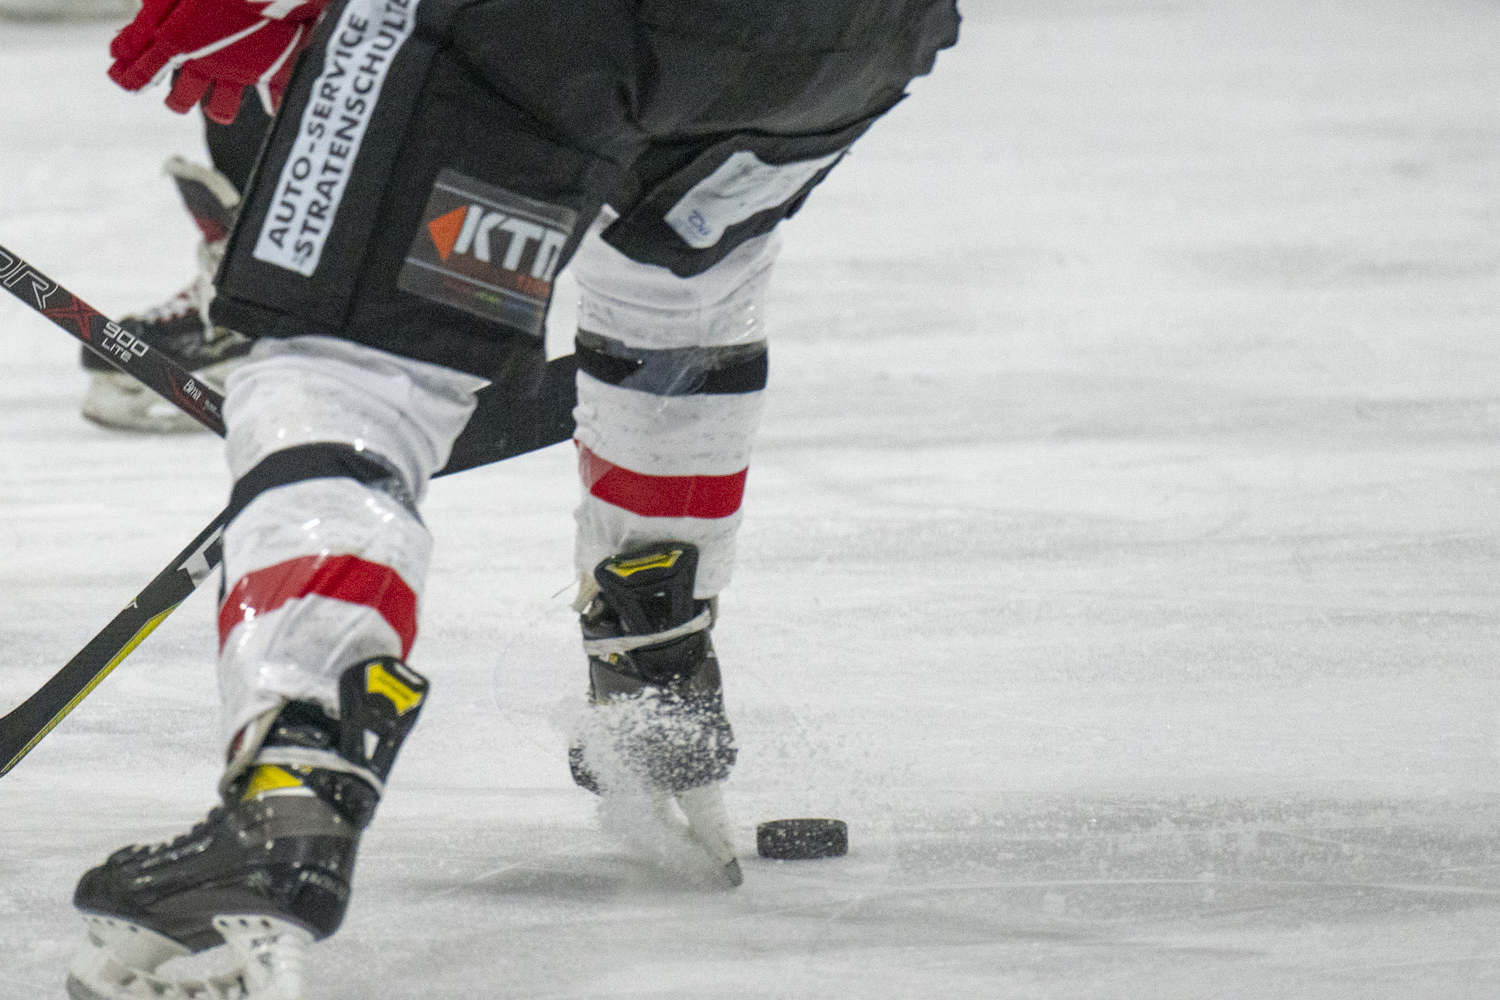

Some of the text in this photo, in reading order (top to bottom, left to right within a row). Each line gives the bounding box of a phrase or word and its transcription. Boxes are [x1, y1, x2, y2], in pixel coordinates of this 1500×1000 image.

[268, 10, 368, 249] AUTO-SERVICE
[101, 338, 133, 363] LITE
[103, 320, 150, 358] 900
